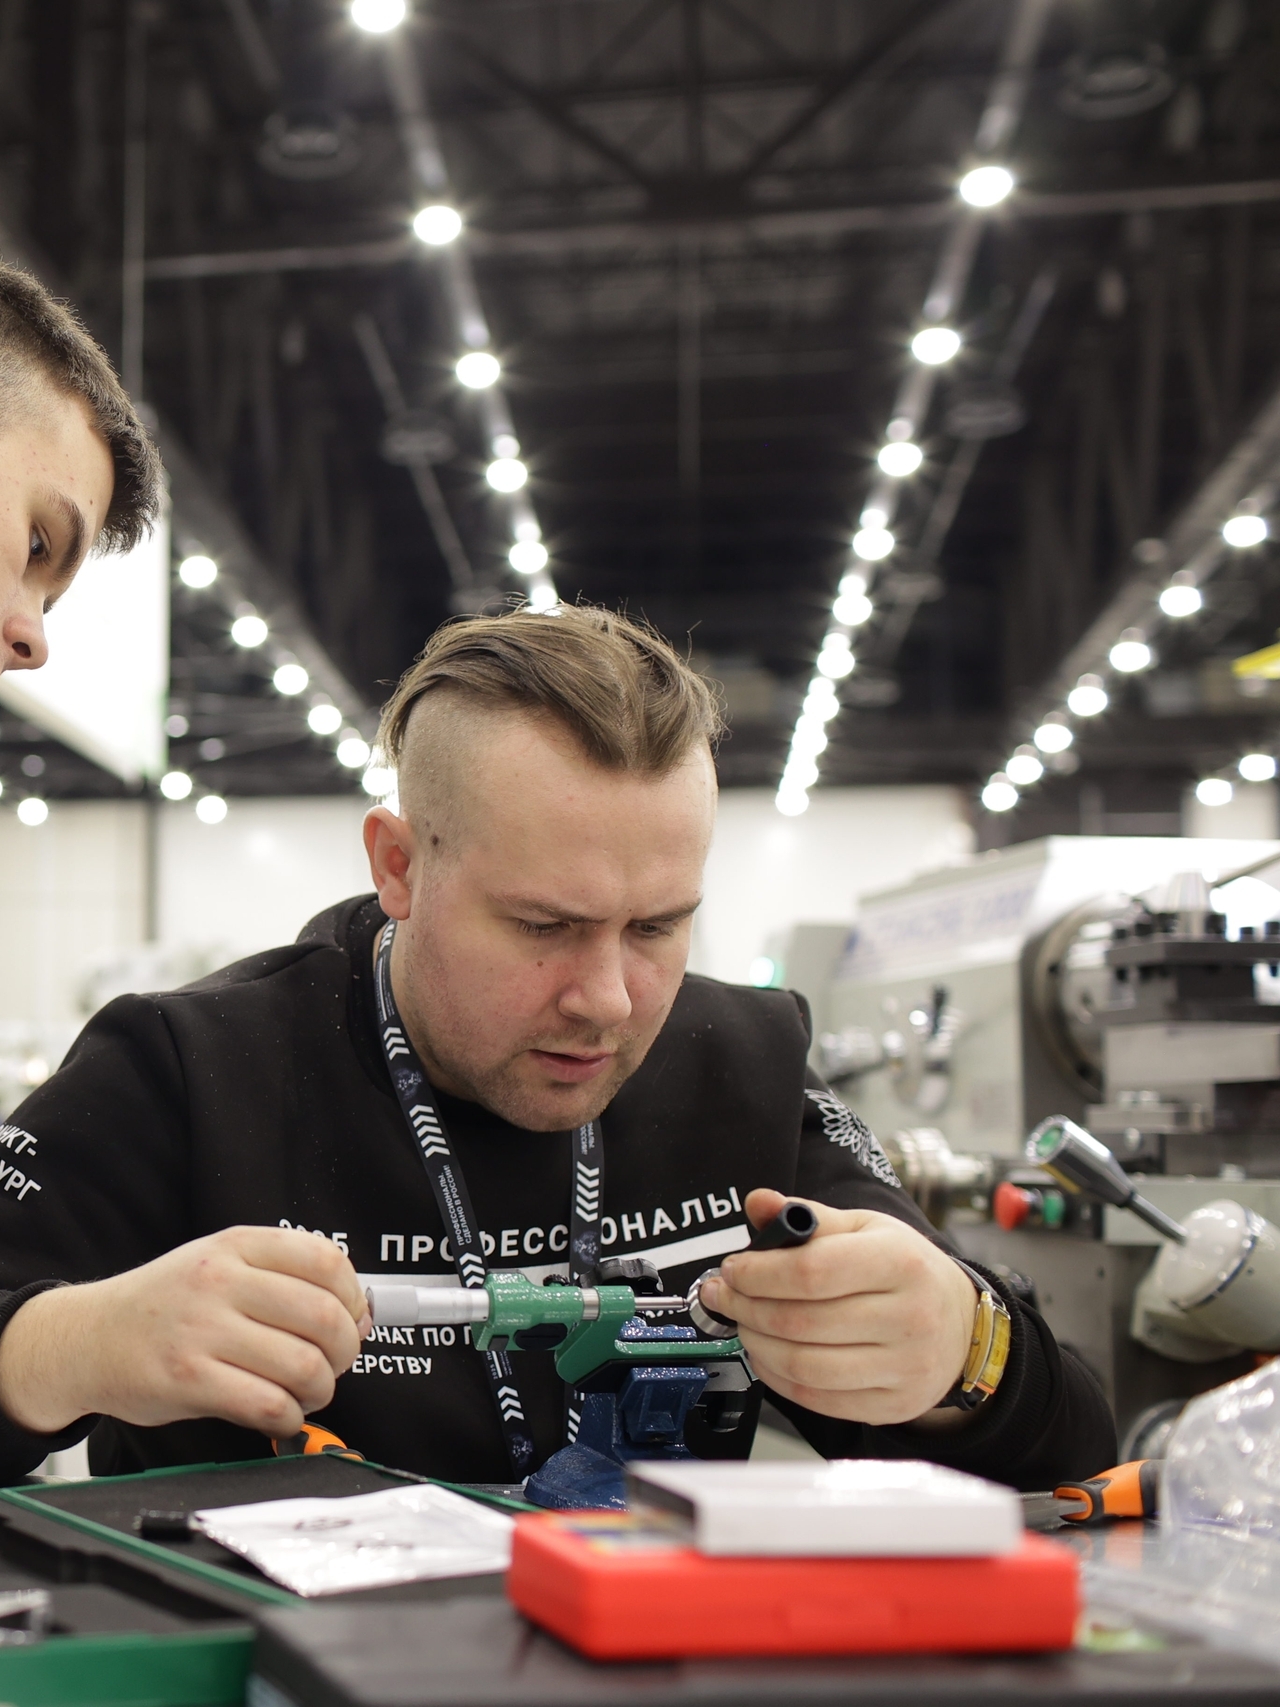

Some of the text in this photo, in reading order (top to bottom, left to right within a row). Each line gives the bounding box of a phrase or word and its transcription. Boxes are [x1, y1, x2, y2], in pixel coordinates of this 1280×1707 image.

[456, 1206, 472, 1244] СДЕЛАНО
[422, 1326, 456, 1346] ПО
[351, 1354, 432, 1375] ЕРСТВУ
